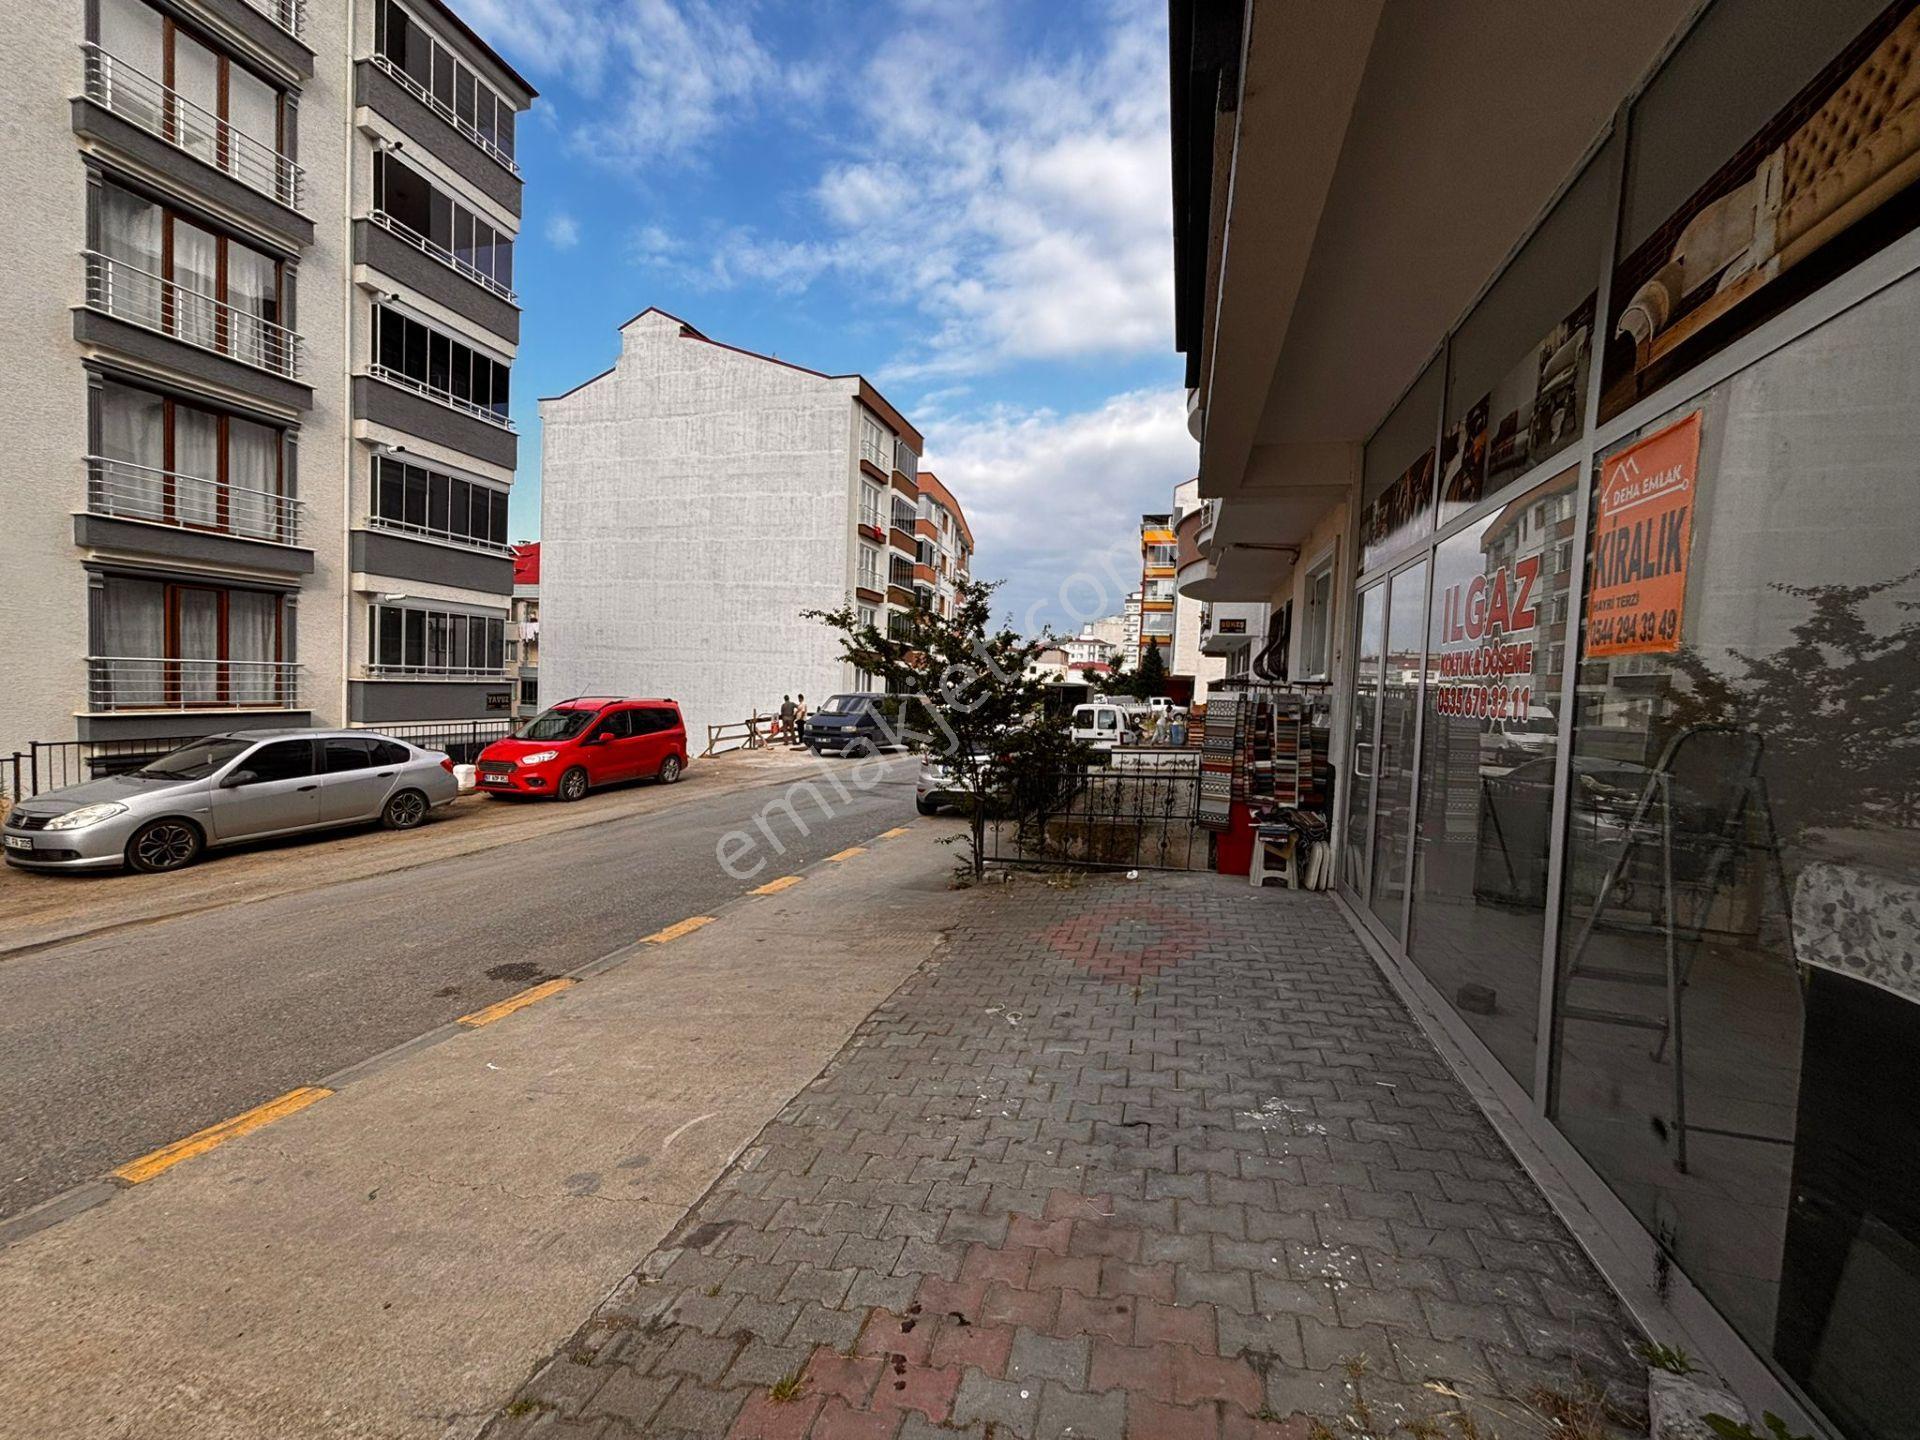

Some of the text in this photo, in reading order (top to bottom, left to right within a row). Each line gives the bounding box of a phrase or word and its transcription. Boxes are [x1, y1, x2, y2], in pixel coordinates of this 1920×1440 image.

[1613, 464, 1683, 506] DEHA EMLAK
[1594, 506, 1687, 590] KİRALIK
[1441, 553, 1540, 646] ILGAZ
[1616, 612, 1638, 644] 294
[1640, 611, 1656, 642] 39
[1659, 609, 1677, 640] 49
[1440, 650, 1473, 679] KOLTUK
[1482, 638, 1533, 685] DÖŞEME
[1438, 685, 1531, 723] 0535 678 32 11
